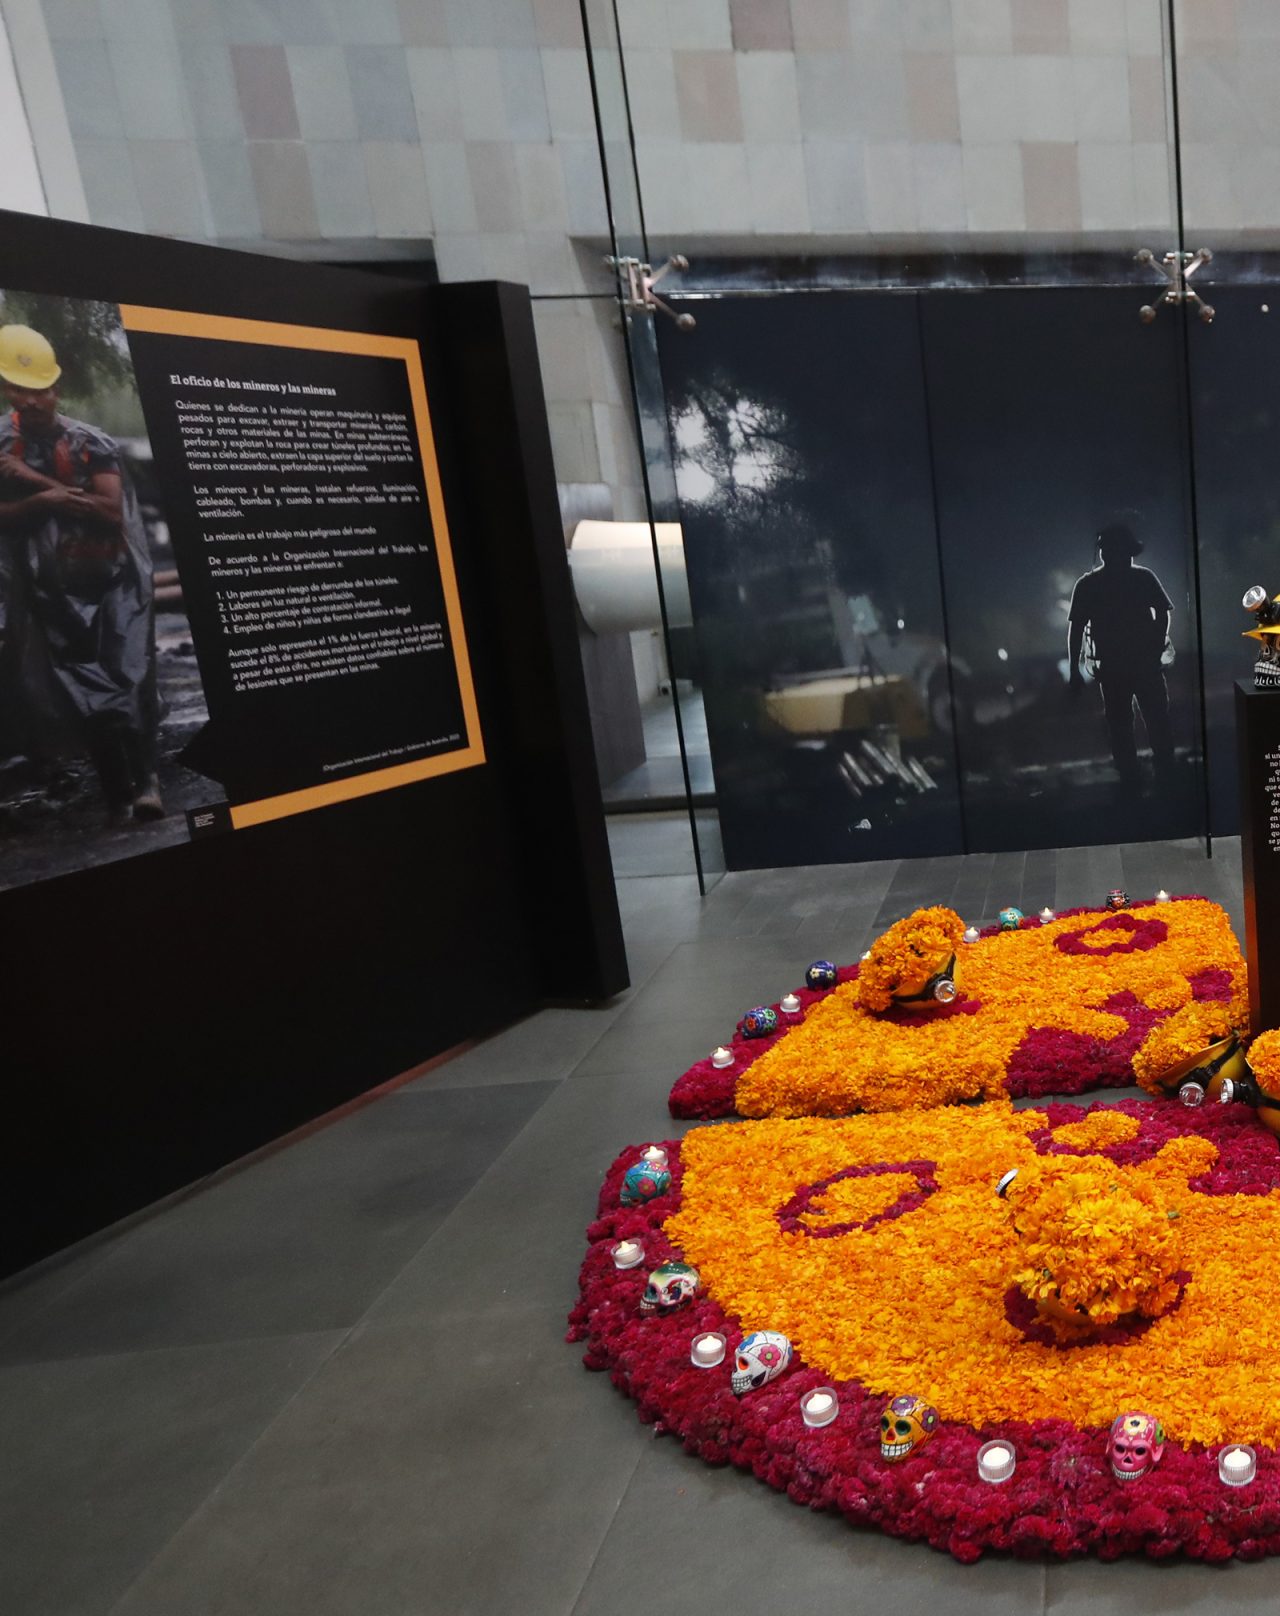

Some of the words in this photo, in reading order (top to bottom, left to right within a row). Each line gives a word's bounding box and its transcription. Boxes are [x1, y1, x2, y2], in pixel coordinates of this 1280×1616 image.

[170, 374, 182, 385] El
[182, 375, 212, 387] oficio
[213, 377, 225, 388] de
[226, 378, 241, 389] los
[242, 380, 280, 392] mineros
[288, 382, 301, 393] las
[302, 384, 336, 396] mineras
[175, 400, 211, 411] Quienes
[227, 403, 259, 413] dedican
[269, 405, 277, 414] la
[309, 410, 334, 419] operan
[188, 461, 212, 470] tierra
[281, 462, 326, 473] perforadoras
[204, 533, 214, 542] La
[215, 531, 245, 541] minería
[257, 530, 264, 539] el
[265, 529, 292, 541] trabajo
[293, 528, 308, 538] más
[309, 528, 341, 539] peligroso
[342, 526, 353, 535] del
[228, 601, 260, 611] Labores
[261, 598, 272, 608] sin
[273, 598, 284, 607] luz
[286, 594, 311, 605] natural
[1265, 752, 1270, 760] si
[1268, 775, 1275, 783] ni
[1265, 785, 1277, 793] que
